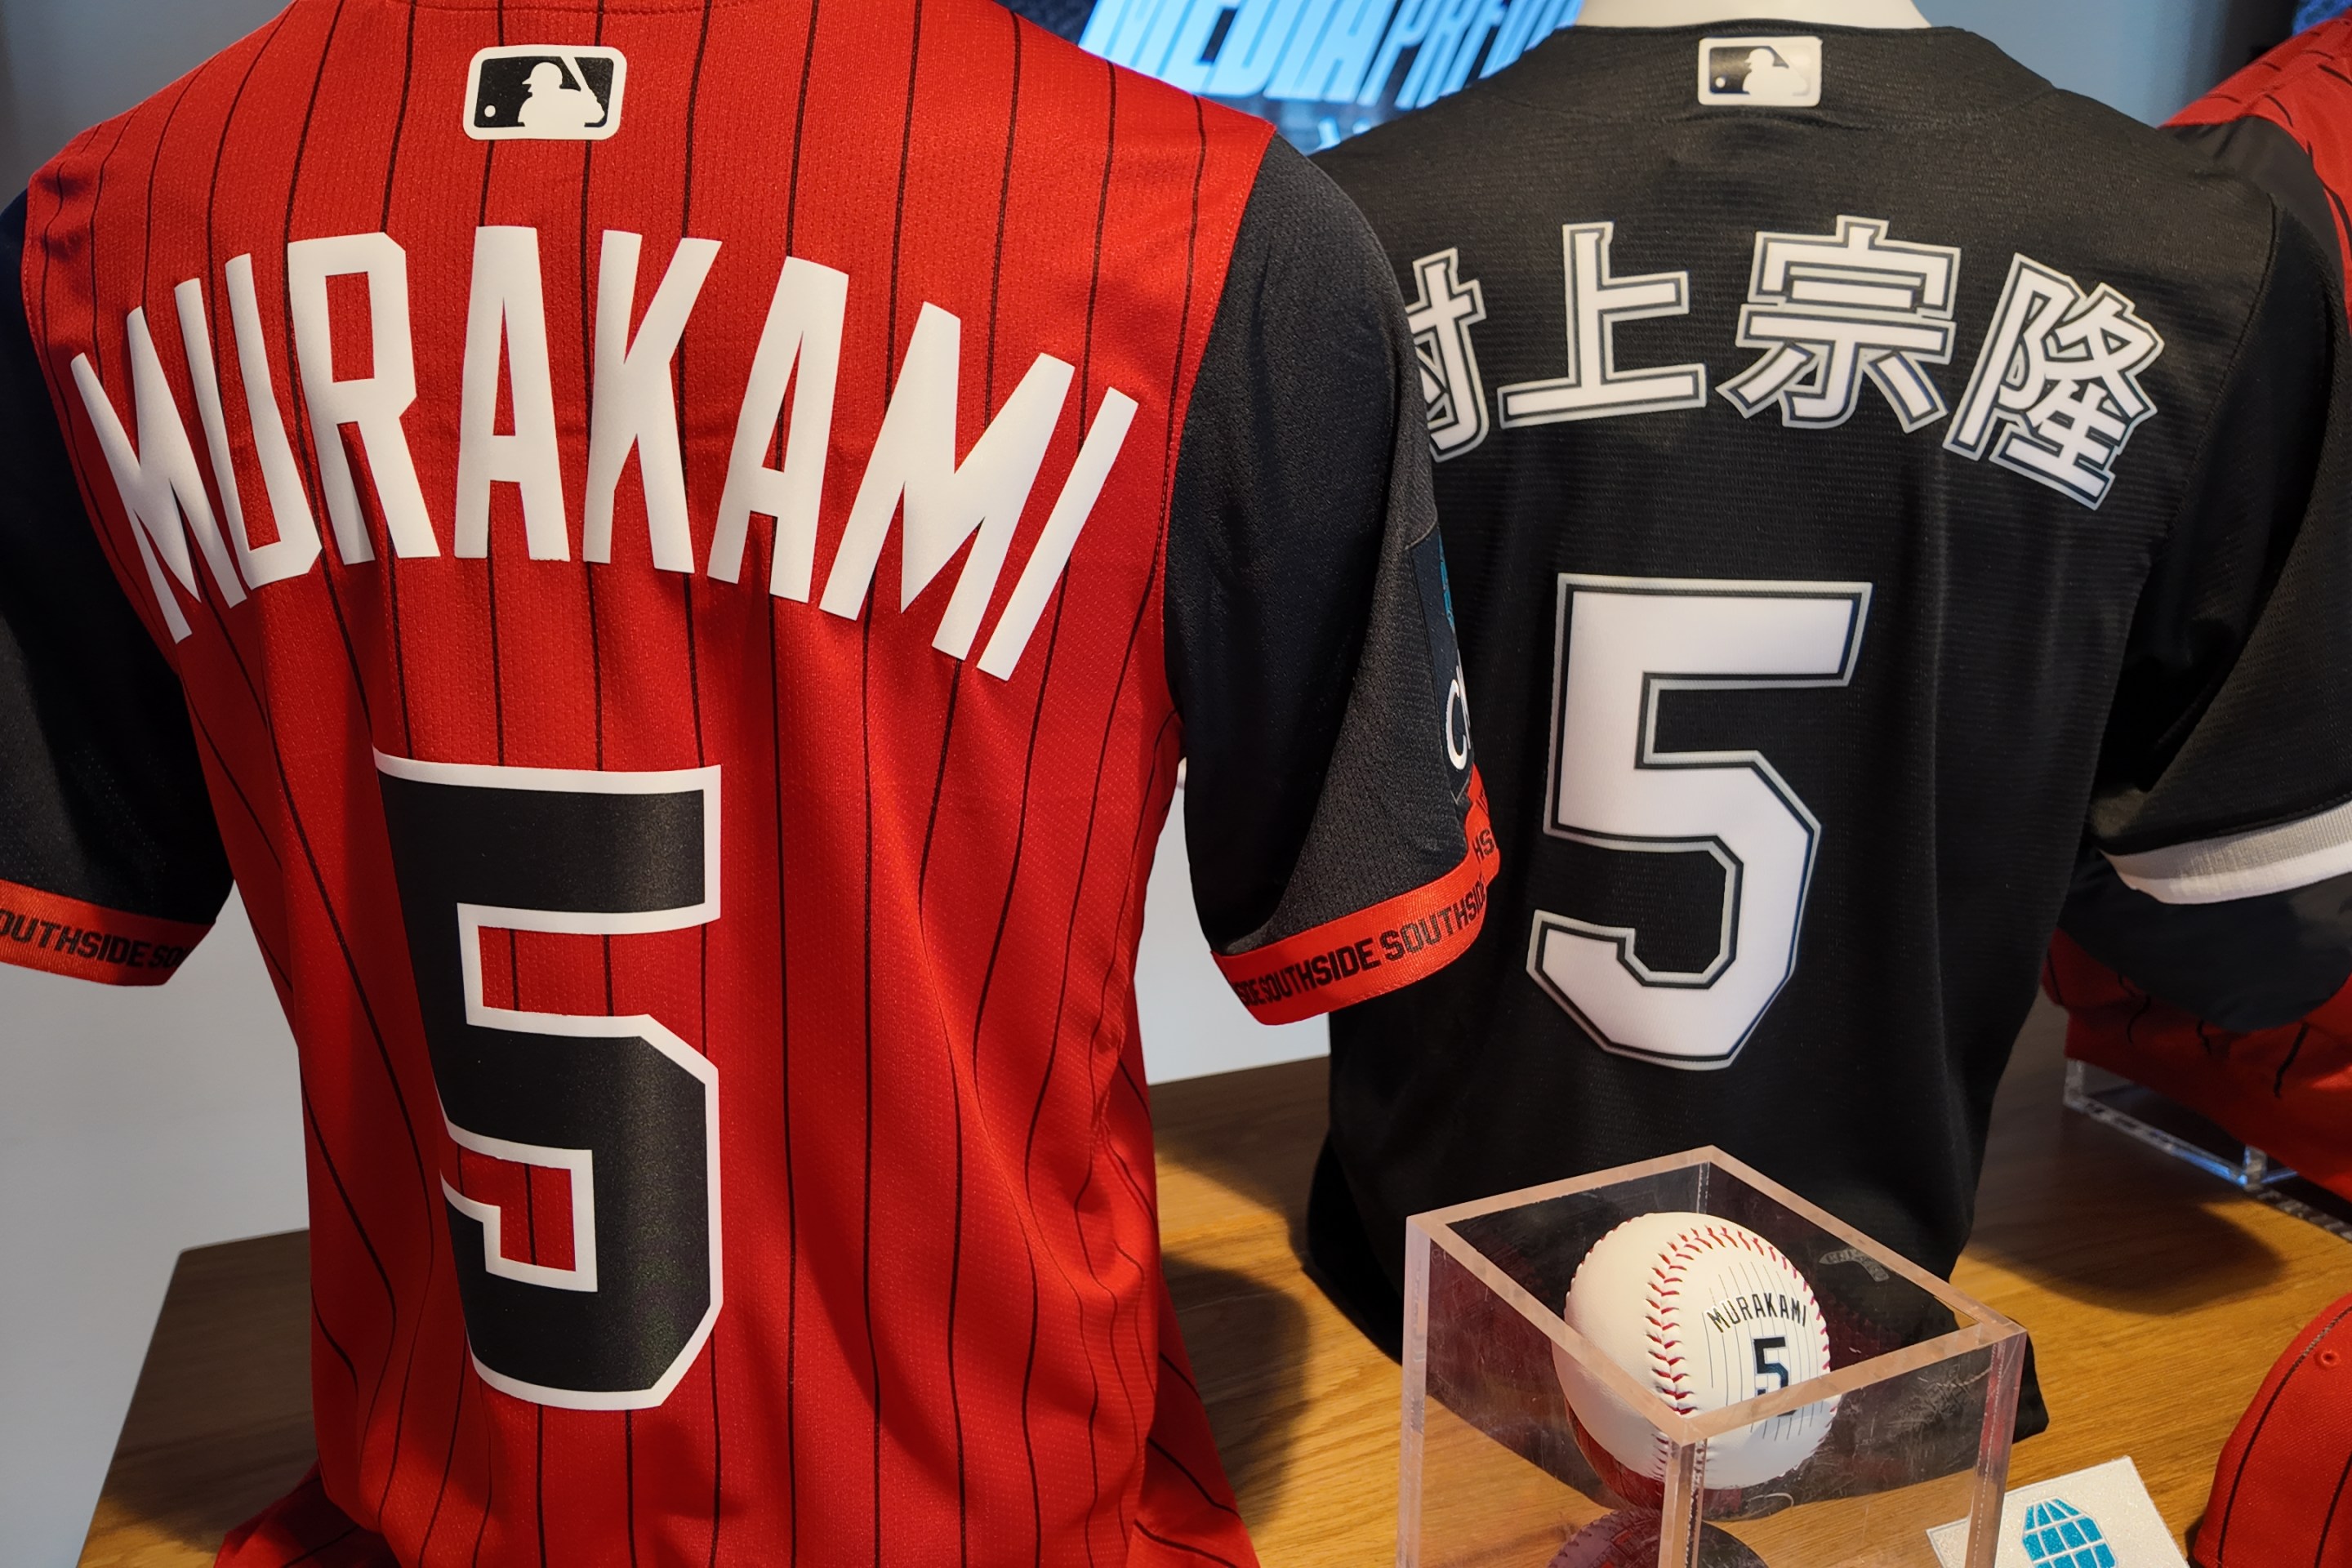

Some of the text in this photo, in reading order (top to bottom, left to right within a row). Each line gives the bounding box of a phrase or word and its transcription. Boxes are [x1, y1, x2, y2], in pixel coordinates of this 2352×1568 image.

[70, 225, 1138, 680] MURAKAMI
[1526, 572, 1873, 1071] 5
[372, 746, 724, 1411] 5
[1258, 938, 1382, 1003] SOUTHSIDE
[1706, 1292, 1807, 1333] MURAKAMI
[1752, 1334, 1797, 1418] 5
